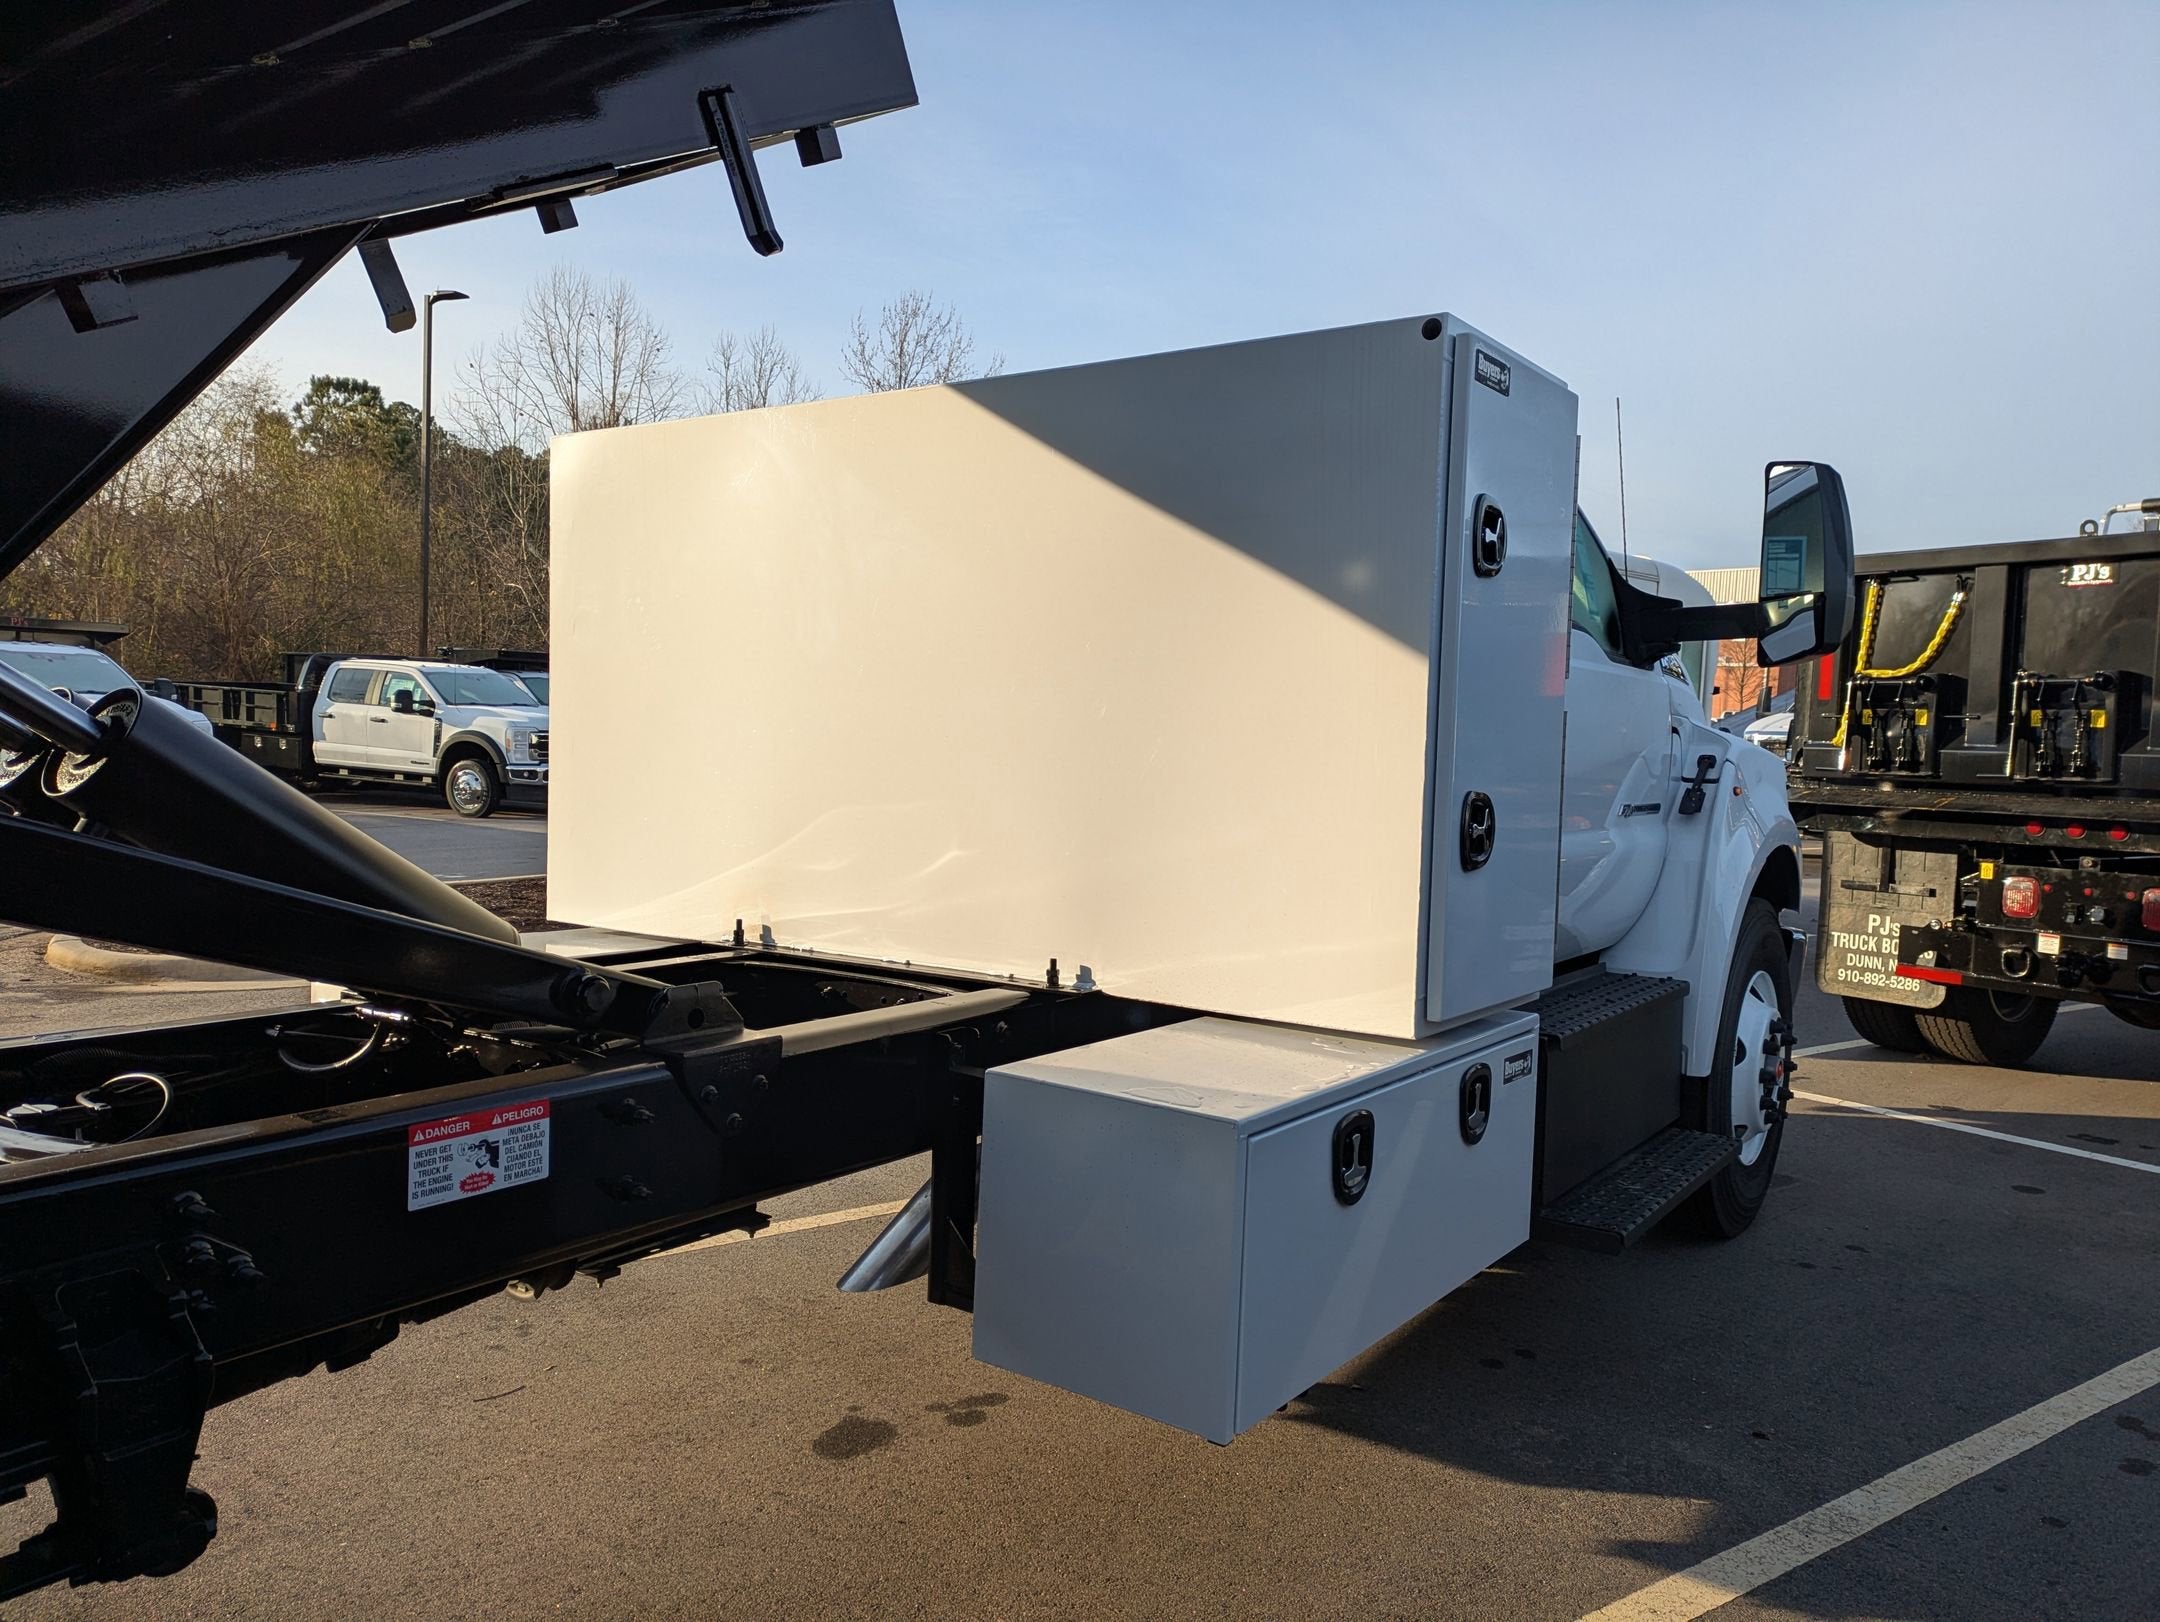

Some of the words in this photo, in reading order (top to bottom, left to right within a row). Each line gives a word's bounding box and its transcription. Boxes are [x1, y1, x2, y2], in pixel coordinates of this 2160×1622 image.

[2070, 563, 2111, 580] PJ's
[1867, 914, 1900, 936] PJ's
[1831, 931, 1878, 952] TRUCK
[1846, 953, 1885, 973] DUNN,
[1837, 968, 1921, 992] 910-892-5286
[502, 1105, 544, 1122] PELIGRO
[425, 1121, 471, 1139] DANGER
[532, 1122, 541, 1131] SE
[502, 1135, 520, 1147] META
[521, 1130, 546, 1141] DEBAJO
[414, 1147, 438, 1159] NEVER
[439, 1144, 453, 1154] GET
[504, 1145, 517, 1155] DEL
[506, 1152, 532, 1164] CUANDO
[533, 1149, 541, 1157] EL
[413, 1158, 437, 1170] UNDER
[438, 1154, 454, 1164] THIS
[503, 1162, 527, 1173] MOTOR
[417, 1167, 441, 1178] TRUCK
[442, 1164, 449, 1173] IF
[503, 1174, 513, 1182] EN
[513, 1166, 543, 1179] MARCHA!
[413, 1180, 427, 1189] THE
[428, 1173, 454, 1185] ENGINE
[411, 1190, 420, 1200] IS
[420, 1183, 454, 1198] RUNNING!
